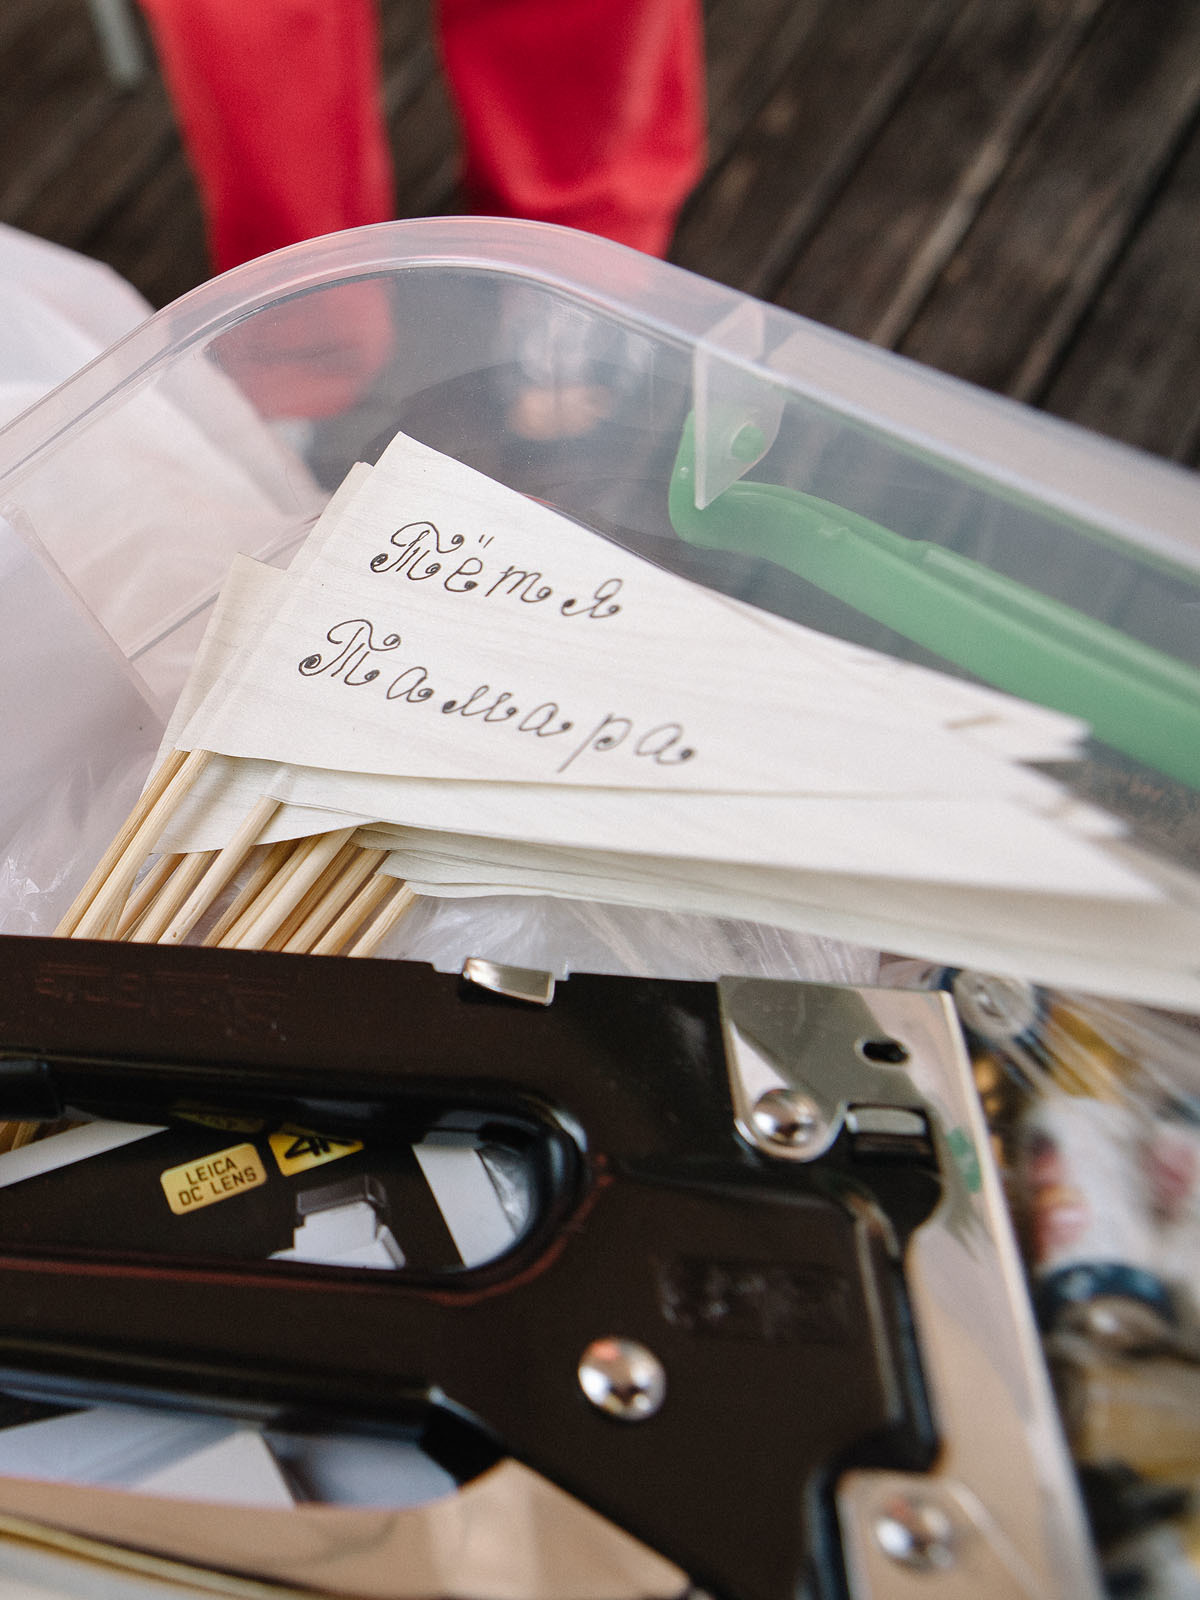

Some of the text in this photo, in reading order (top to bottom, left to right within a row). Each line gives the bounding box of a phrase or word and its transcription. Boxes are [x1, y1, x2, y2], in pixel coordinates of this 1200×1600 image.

[370, 520, 624, 619] Тётя
[298, 618, 698, 774] Тамара
[178, 1167, 258, 1207] DC LENS
[185, 1157, 238, 1185] LEICA
